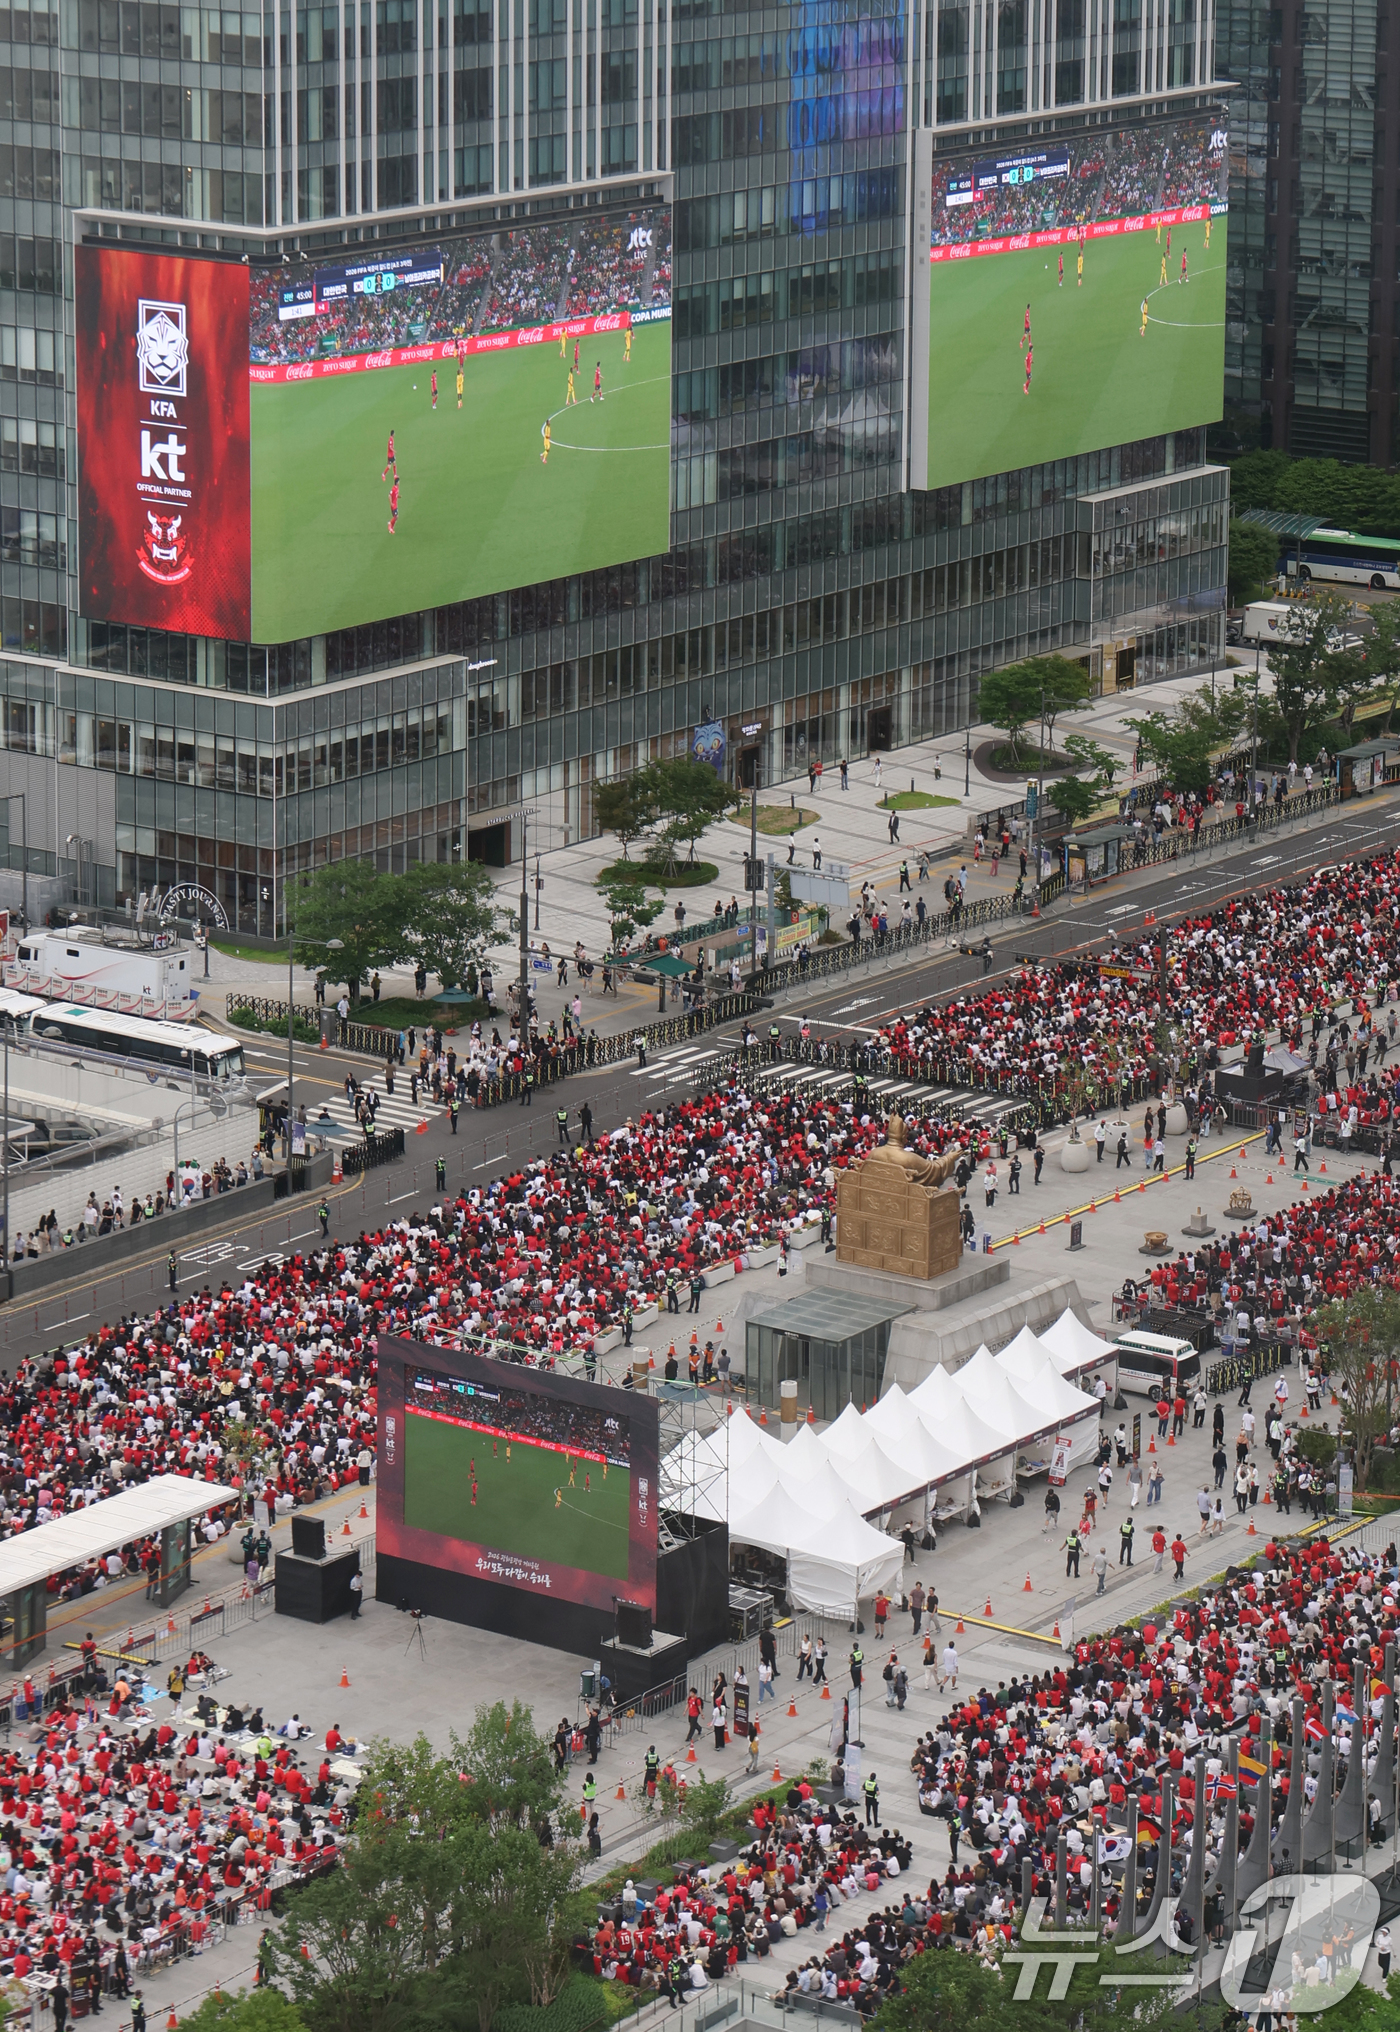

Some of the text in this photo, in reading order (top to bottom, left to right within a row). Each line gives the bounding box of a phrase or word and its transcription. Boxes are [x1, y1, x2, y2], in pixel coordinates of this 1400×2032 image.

[634, 250, 648, 260] LIVE
[296, 290, 312, 301] 45:00
[323, 284, 348, 296] 대한민국
[631, 311, 650, 323] COPA
[286, 362, 314, 380] Coca-Cola
[323, 362, 337, 373] zero
[338, 359, 357, 371] sugar
[365, 352, 392, 369] Coca-Cola
[400, 351, 416, 361] zero
[416, 348, 435, 359] sugar
[476, 339, 491, 349] zero
[492, 336, 510, 347] sugar
[517, 327, 544, 345] Coca-Cola
[593, 314, 621, 331] Coca-Cola
[150, 399, 177, 419] KFA
[141, 430, 187, 482] kt
[136, 483, 192, 498] OFFICIAL PARTNER
[487, 813, 513, 826] STARBUCKS
[163, 888, 226, 930] TASTY JOURNEY
[143, 985, 151, 995] kt
[1127, 1369, 1157, 1379] AMBULANCE
[386, 1438, 395, 1448] kt
[639, 1500, 647, 1510] kt
[487, 1551, 500, 1560] 2026
[475, 1558, 490, 1572] 우리
[491, 1562, 505, 1577] 모두
[529, 1571, 553, 1588] 승리를
[1170, 1685, 1178, 1695] 10
[1044, 1858, 1051, 1867] 13
[621, 1934, 631, 1945] 19
